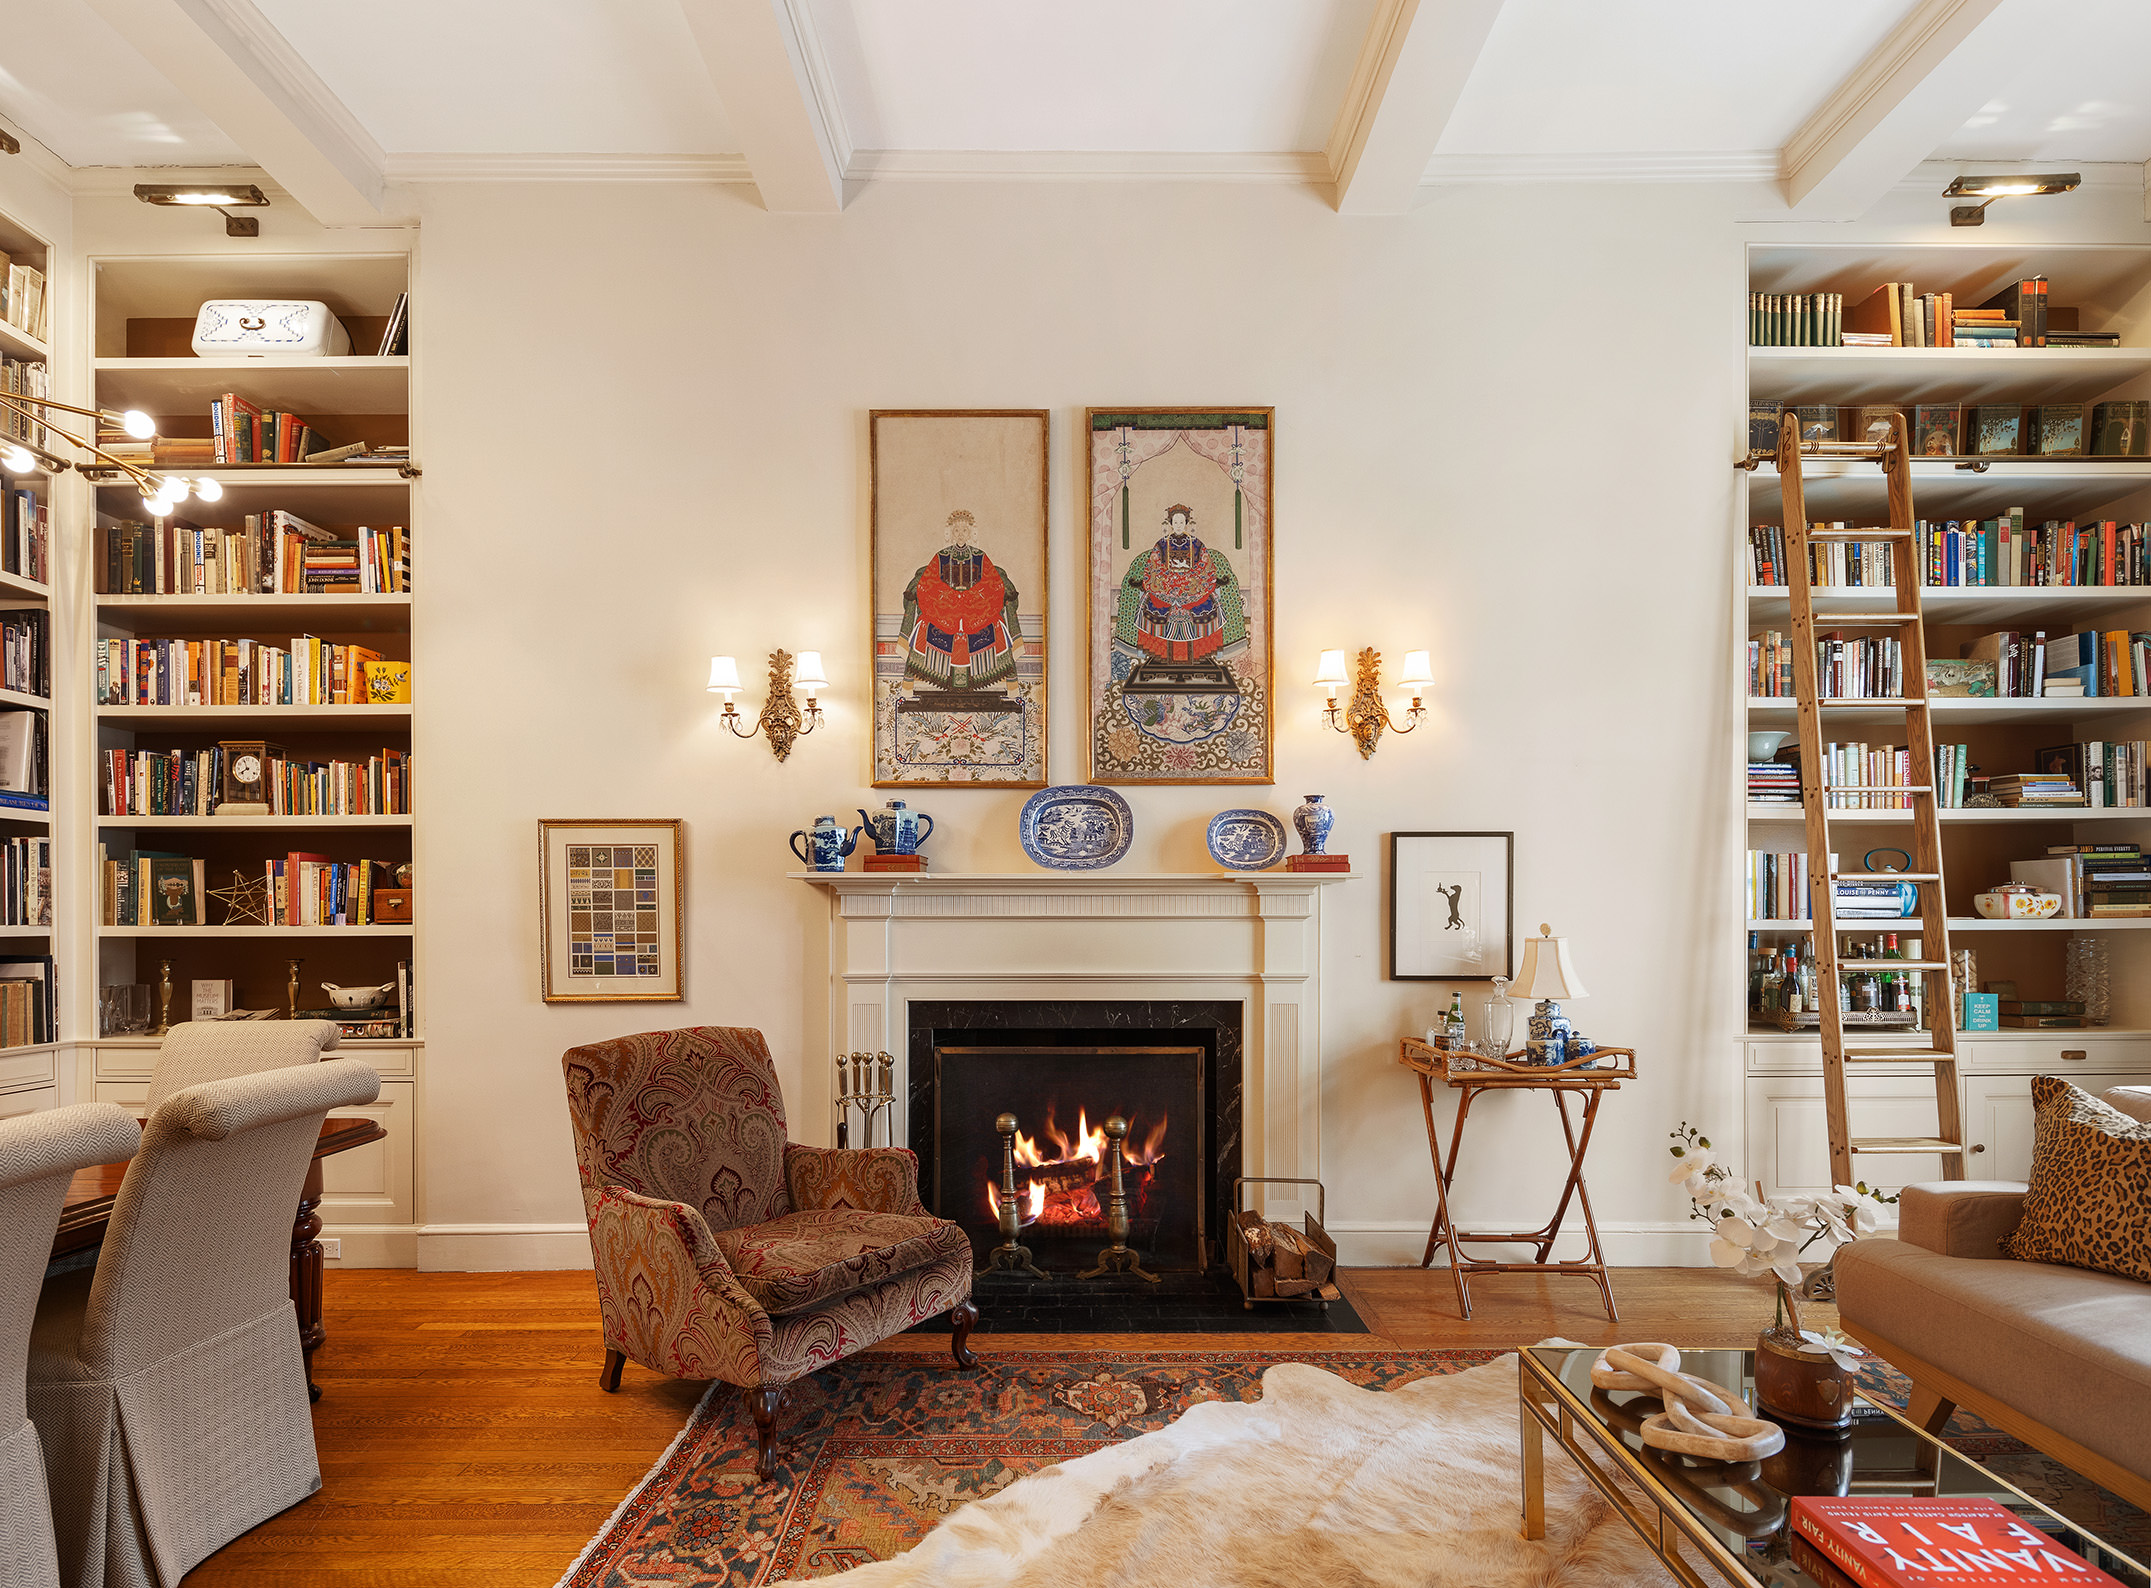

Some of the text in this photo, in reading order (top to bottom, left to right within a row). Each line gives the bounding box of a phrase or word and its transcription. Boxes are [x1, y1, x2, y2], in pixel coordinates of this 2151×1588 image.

[213, 402, 221, 429] HOUDINI
[98, 641, 107, 667] D-DAY
[171, 764, 180, 782] 1776
[1956, 748, 1965, 779] TRUST
[117, 884, 129, 919] Lusitania
[1840, 1521, 2045, 1546] FAIR
[1801, 1515, 1867, 1580] VANITY FAIR
[1884, 1547, 2087, 1573] VANITY
